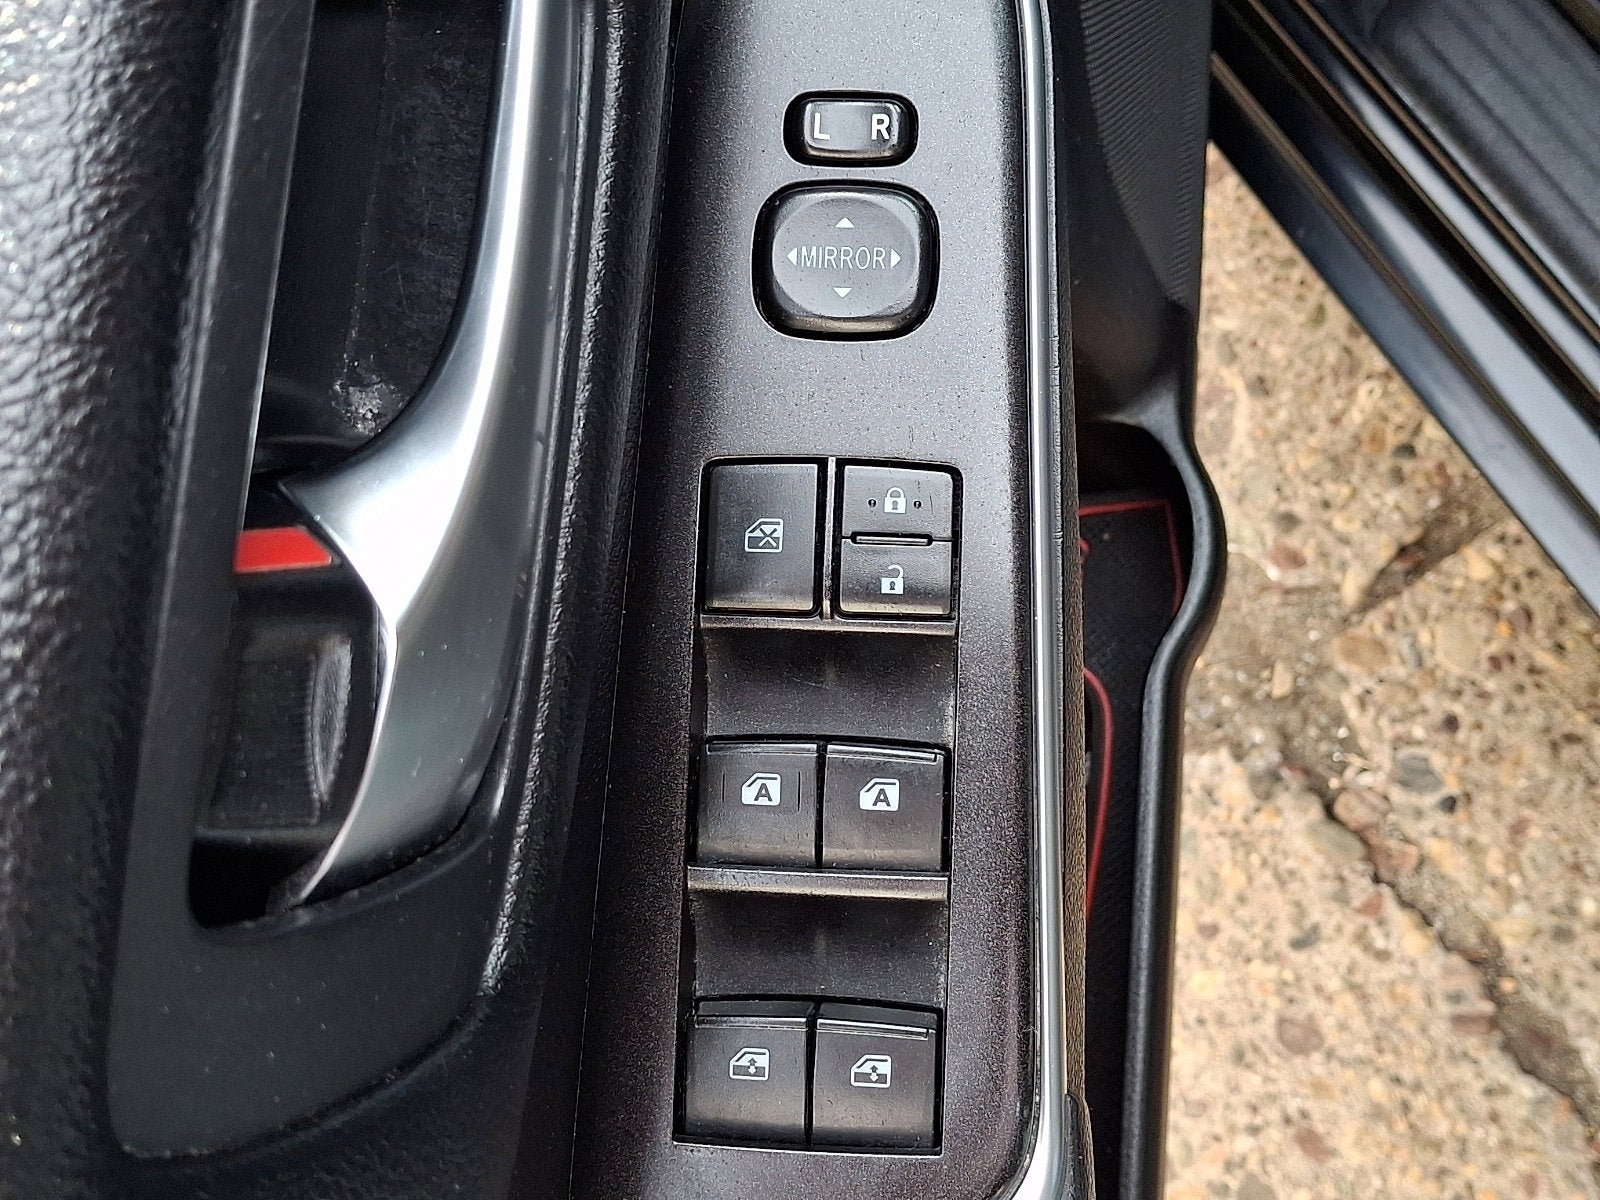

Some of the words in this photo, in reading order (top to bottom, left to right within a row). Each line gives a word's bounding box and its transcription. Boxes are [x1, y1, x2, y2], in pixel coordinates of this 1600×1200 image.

[813, 112, 831, 140] L
[871, 113, 891, 141] R
[800, 245, 887, 270] MIRROR
[753, 782, 773, 802] A
[872, 787, 891, 807] A
